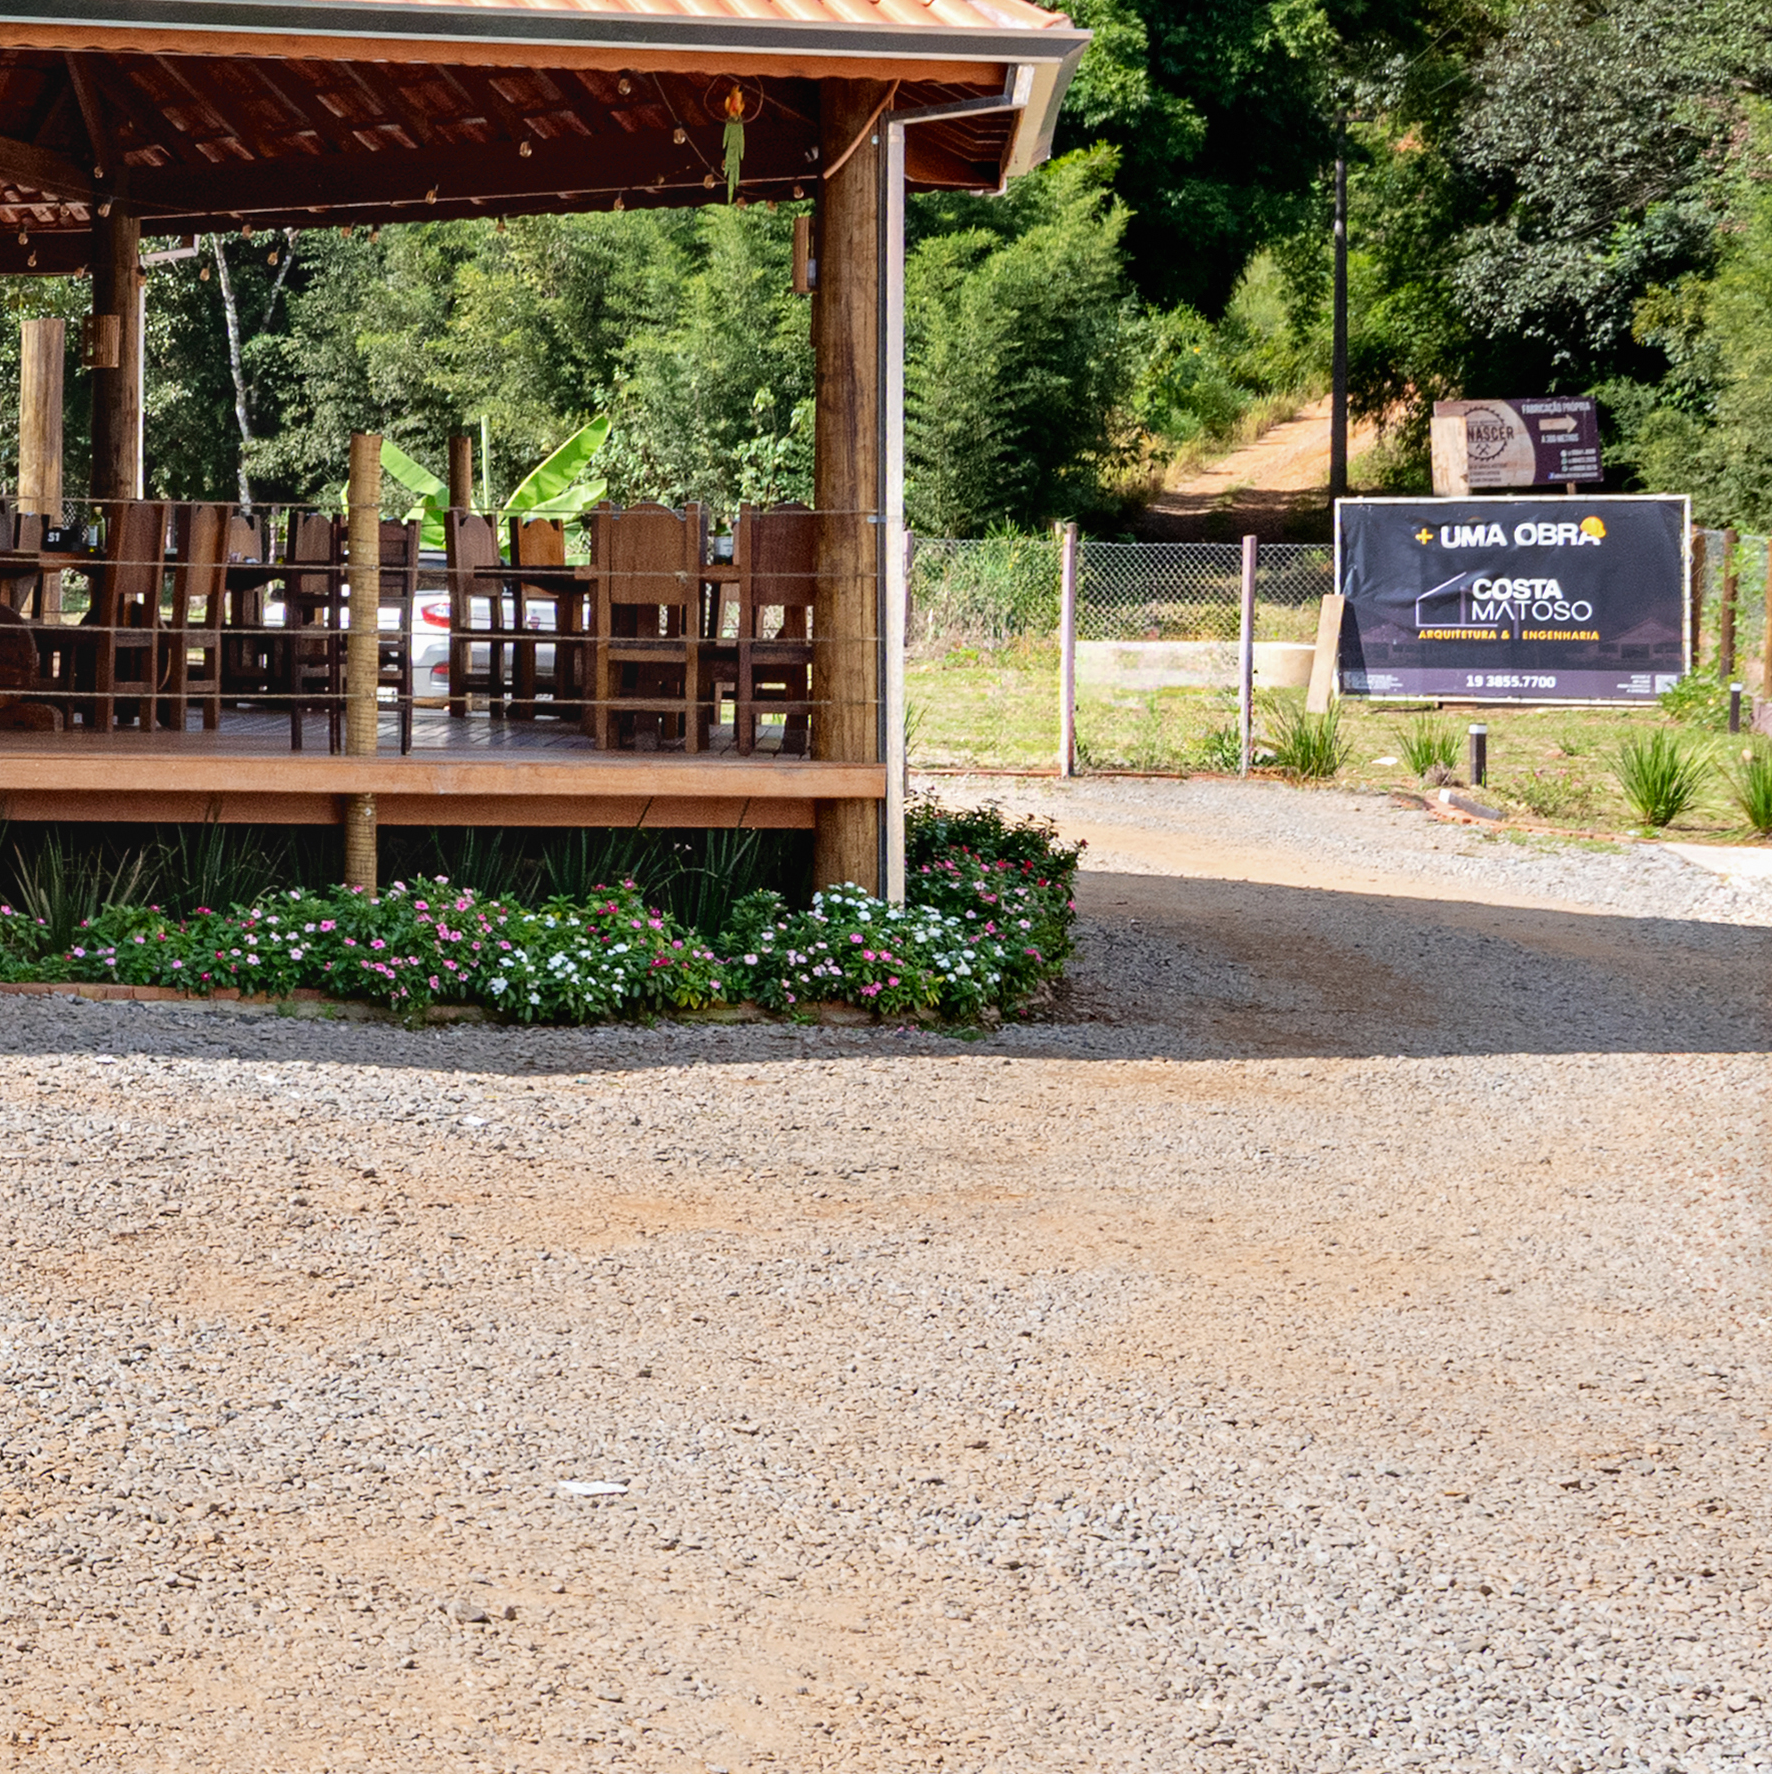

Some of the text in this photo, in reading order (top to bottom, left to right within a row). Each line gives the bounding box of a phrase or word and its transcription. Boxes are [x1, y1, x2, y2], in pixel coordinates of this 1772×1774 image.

[1467, 425, 1514, 443] NASCER
[1441, 524, 1507, 548] UMA
[1514, 522, 1602, 546] OBRA
[1472, 578, 1563, 600] COSTA
[1471, 600, 1593, 621] MATOSO
[1418, 630, 1599, 641] ARQUITETURA & ENGENHARIA
[1466, 674, 1556, 688] 19 3855.7700
